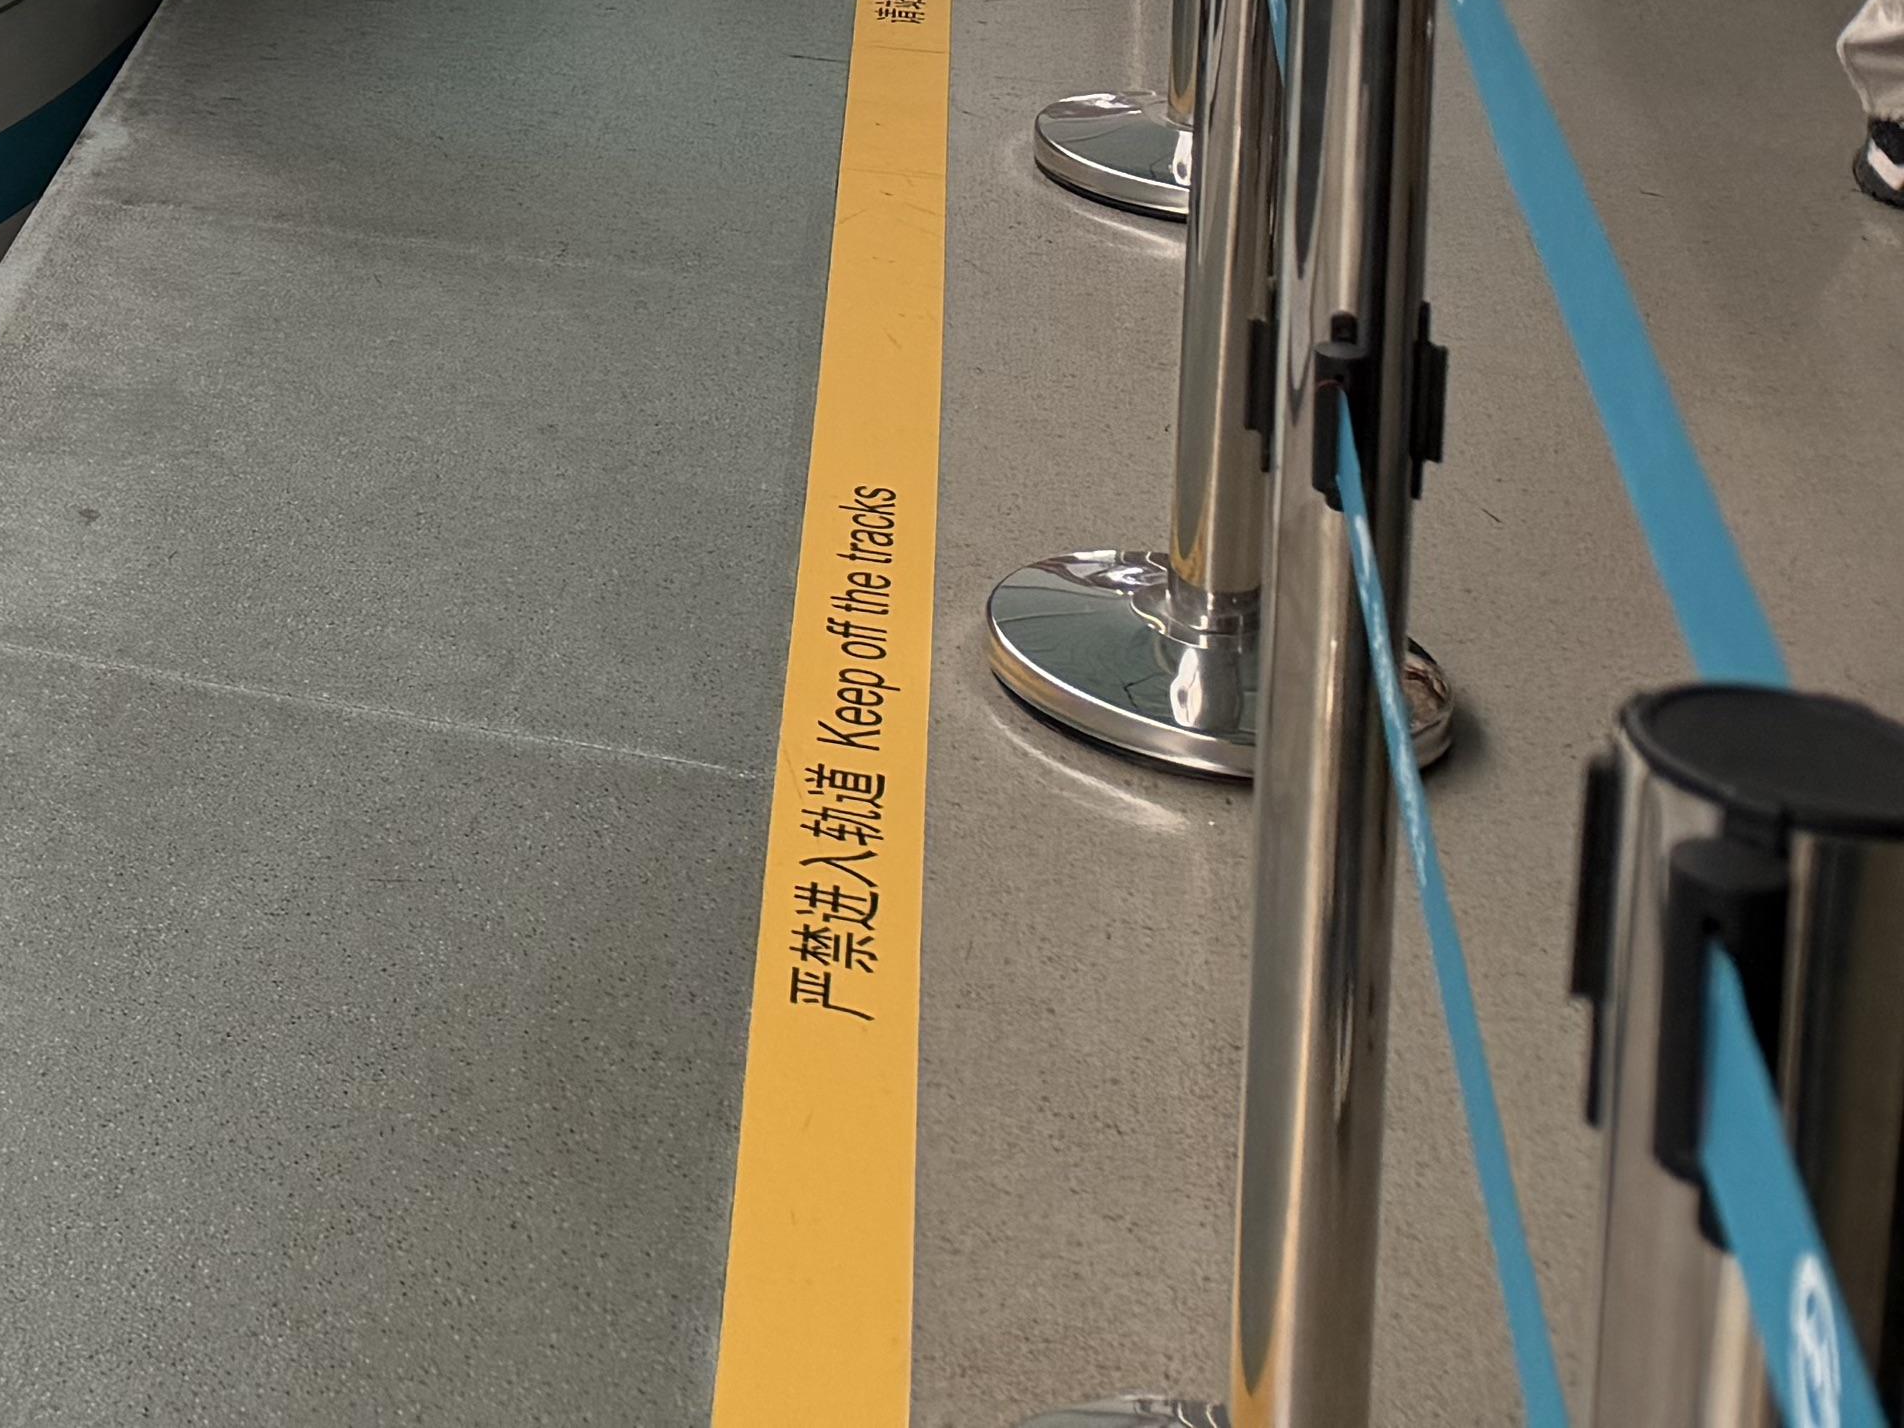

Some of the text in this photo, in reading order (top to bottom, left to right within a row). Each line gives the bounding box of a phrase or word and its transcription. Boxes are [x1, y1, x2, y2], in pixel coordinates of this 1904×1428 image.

[817, 484, 901, 752] Keep off the tracks
[789, 763, 886, 1022] 严禁进入轨道
